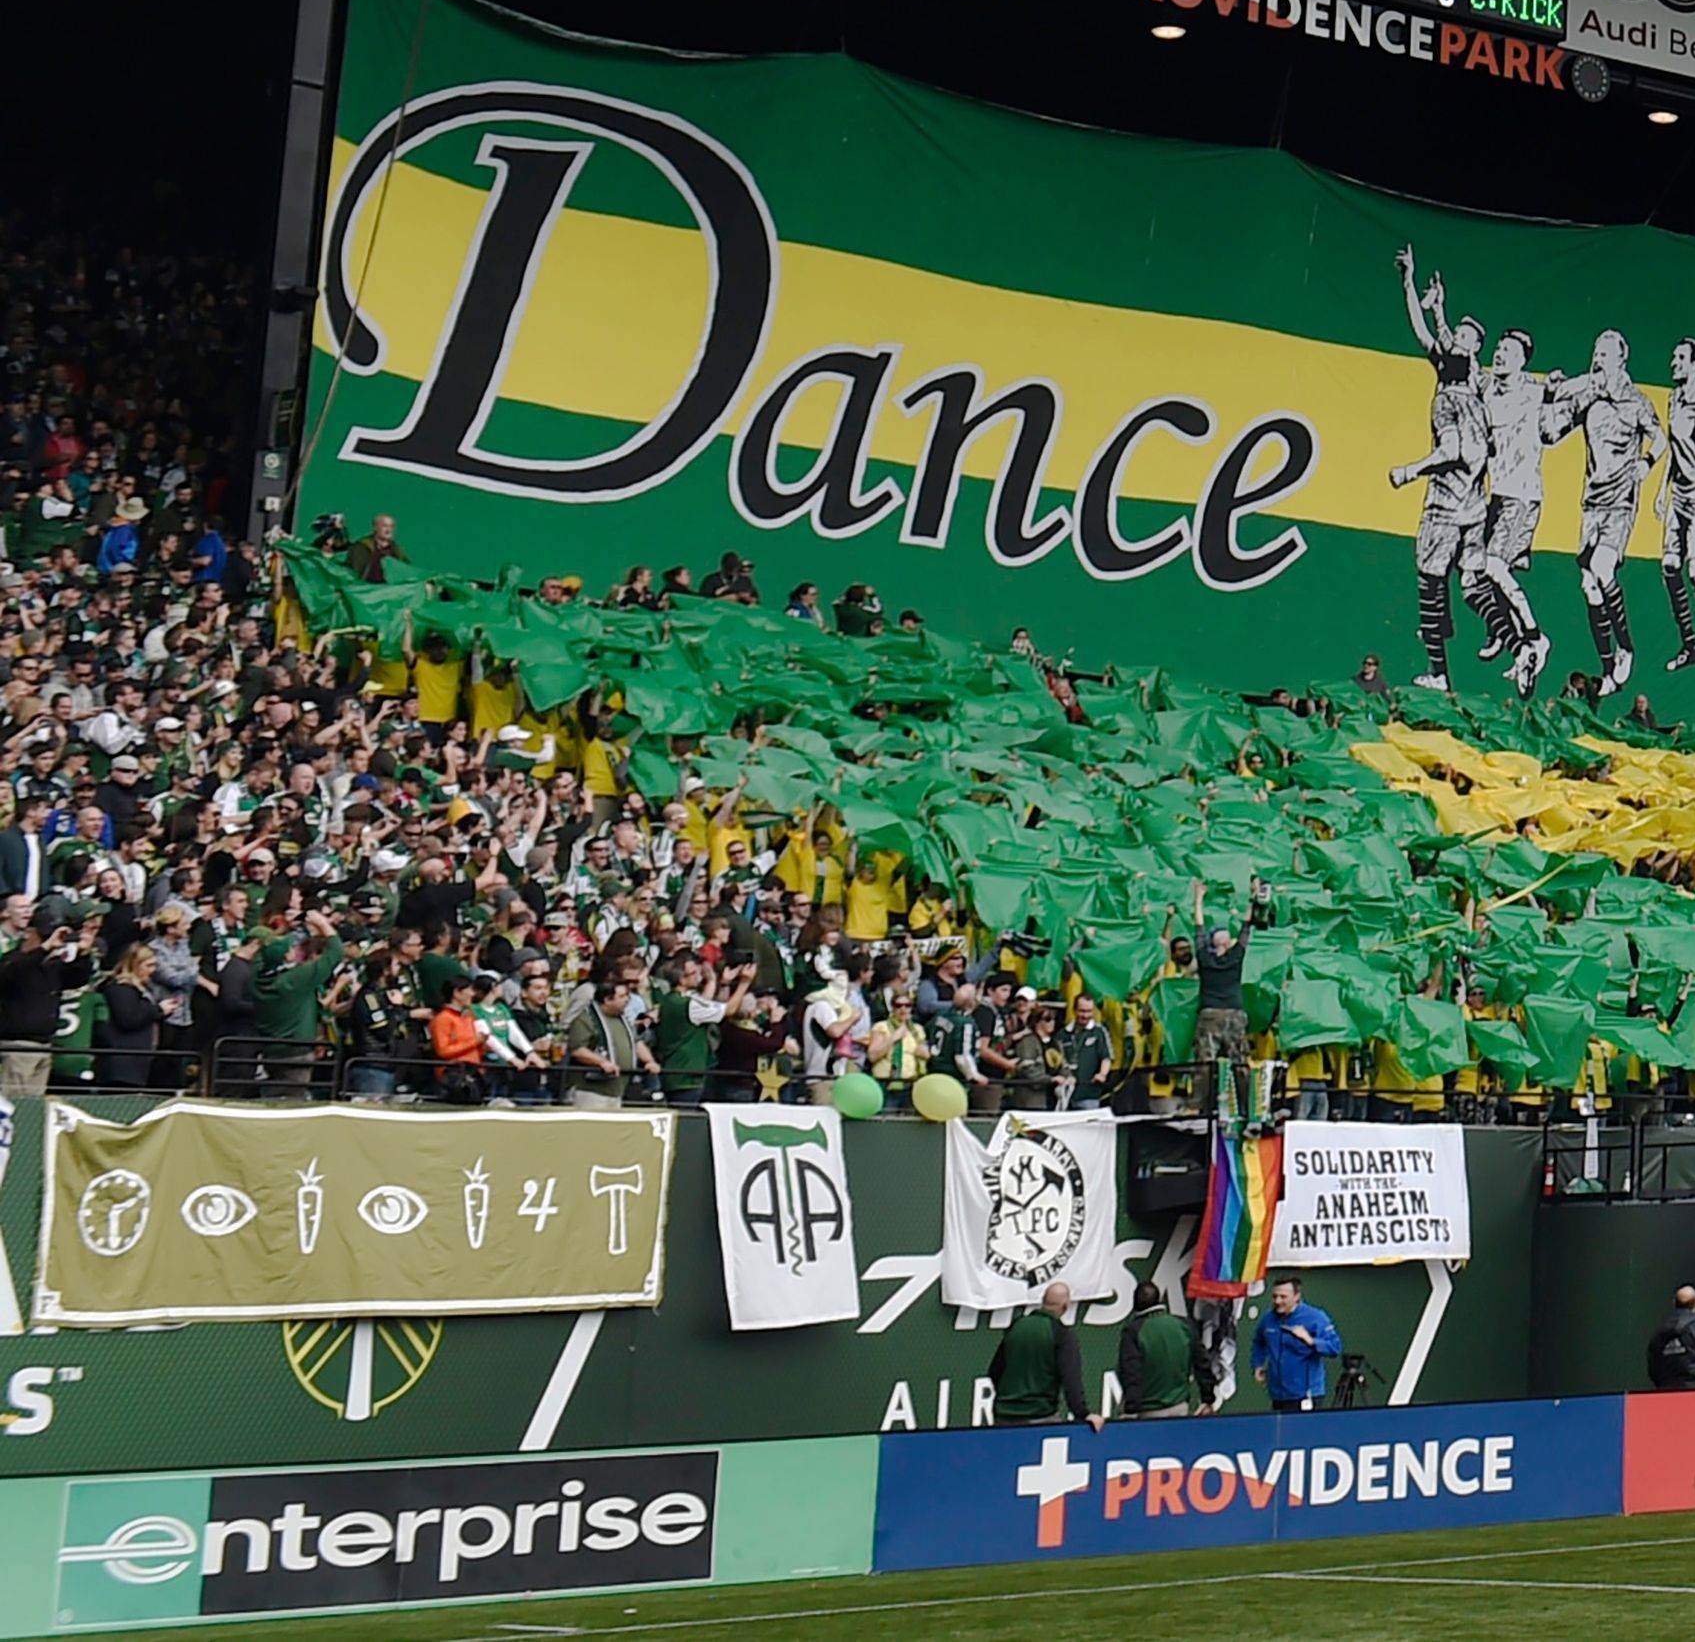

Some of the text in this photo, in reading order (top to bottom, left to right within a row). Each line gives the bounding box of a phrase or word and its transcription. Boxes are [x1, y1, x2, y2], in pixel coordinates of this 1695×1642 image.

[1578, 8, 1659, 51] Audi
[324, 81, 1319, 592] Dance
[1294, 1149, 1435, 1176] SOLIDARITY
[1315, 1190, 1430, 1220] ANAHEIM
[1289, 1217, 1451, 1249] ANTIFASCISTS
[1103, 1434, 1514, 1520] PROVIDENCE
[57, 1479, 710, 1585] enterprise
